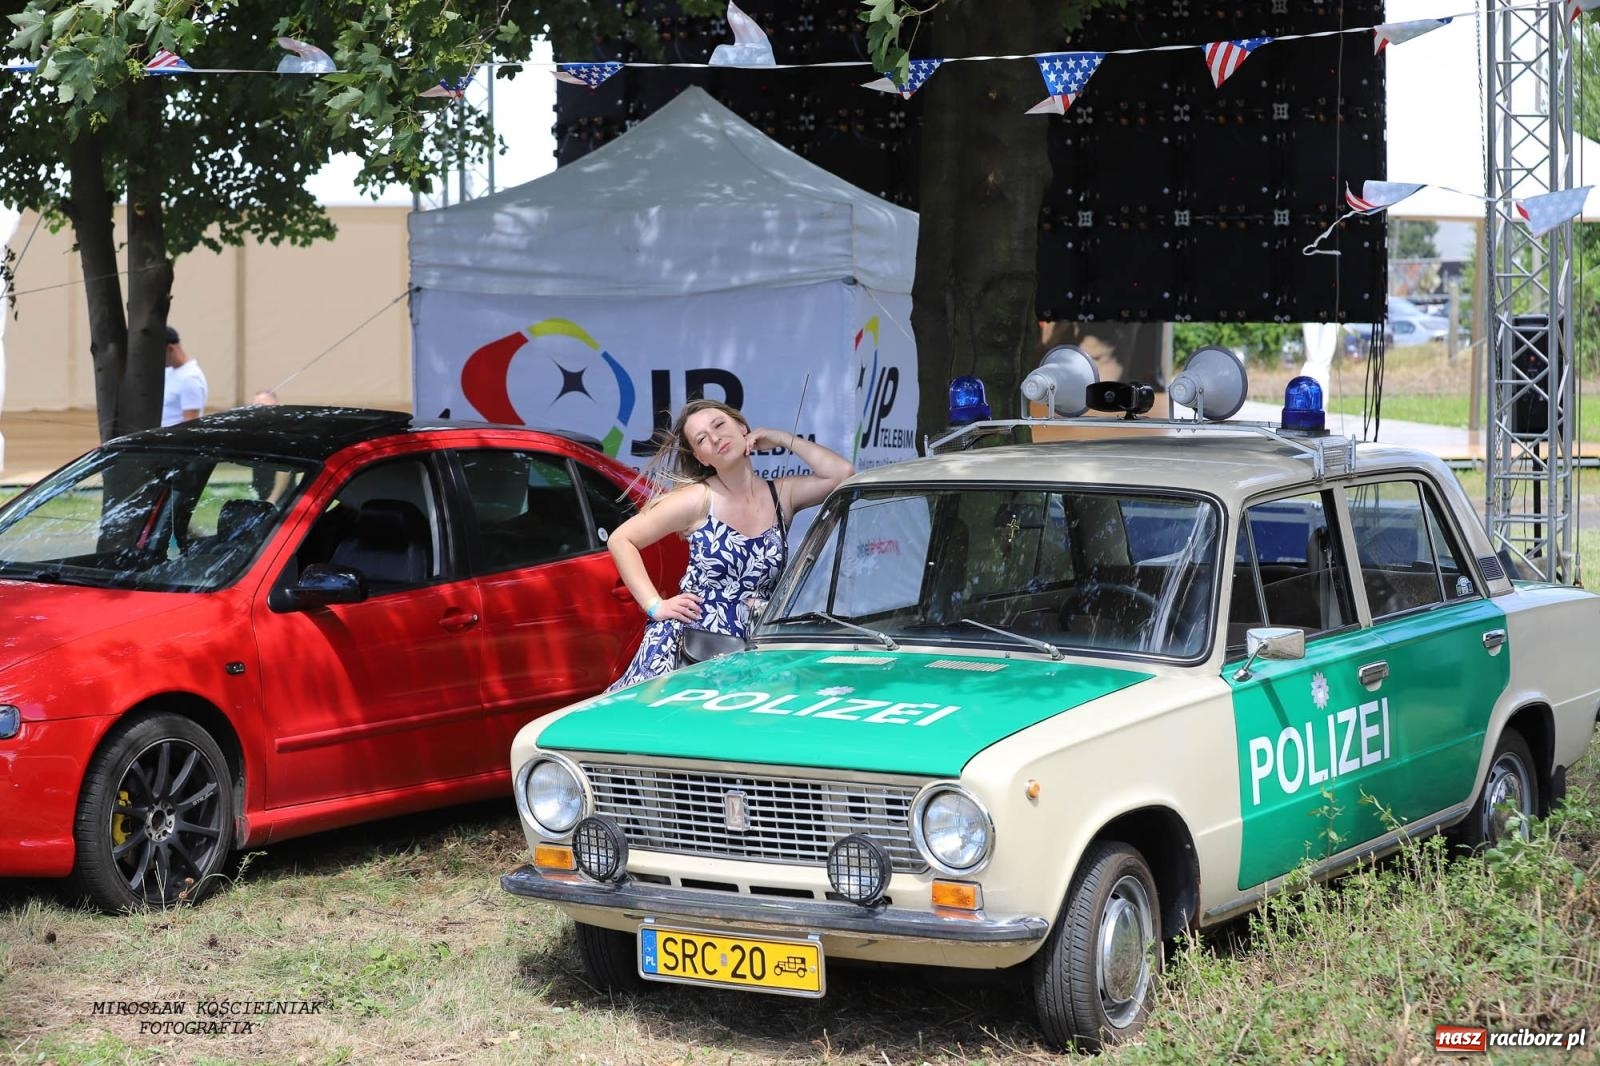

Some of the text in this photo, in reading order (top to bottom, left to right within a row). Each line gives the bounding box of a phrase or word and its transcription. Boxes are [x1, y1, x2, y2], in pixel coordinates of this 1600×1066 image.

[861, 366, 899, 449] JP
[879, 428, 914, 449] TELEBIM
[648, 688, 961, 727] POLIZEI
[1249, 697, 1391, 806] POLIZEI
[645, 956, 656, 966] PL
[662, 937, 767, 981] SRC 20
